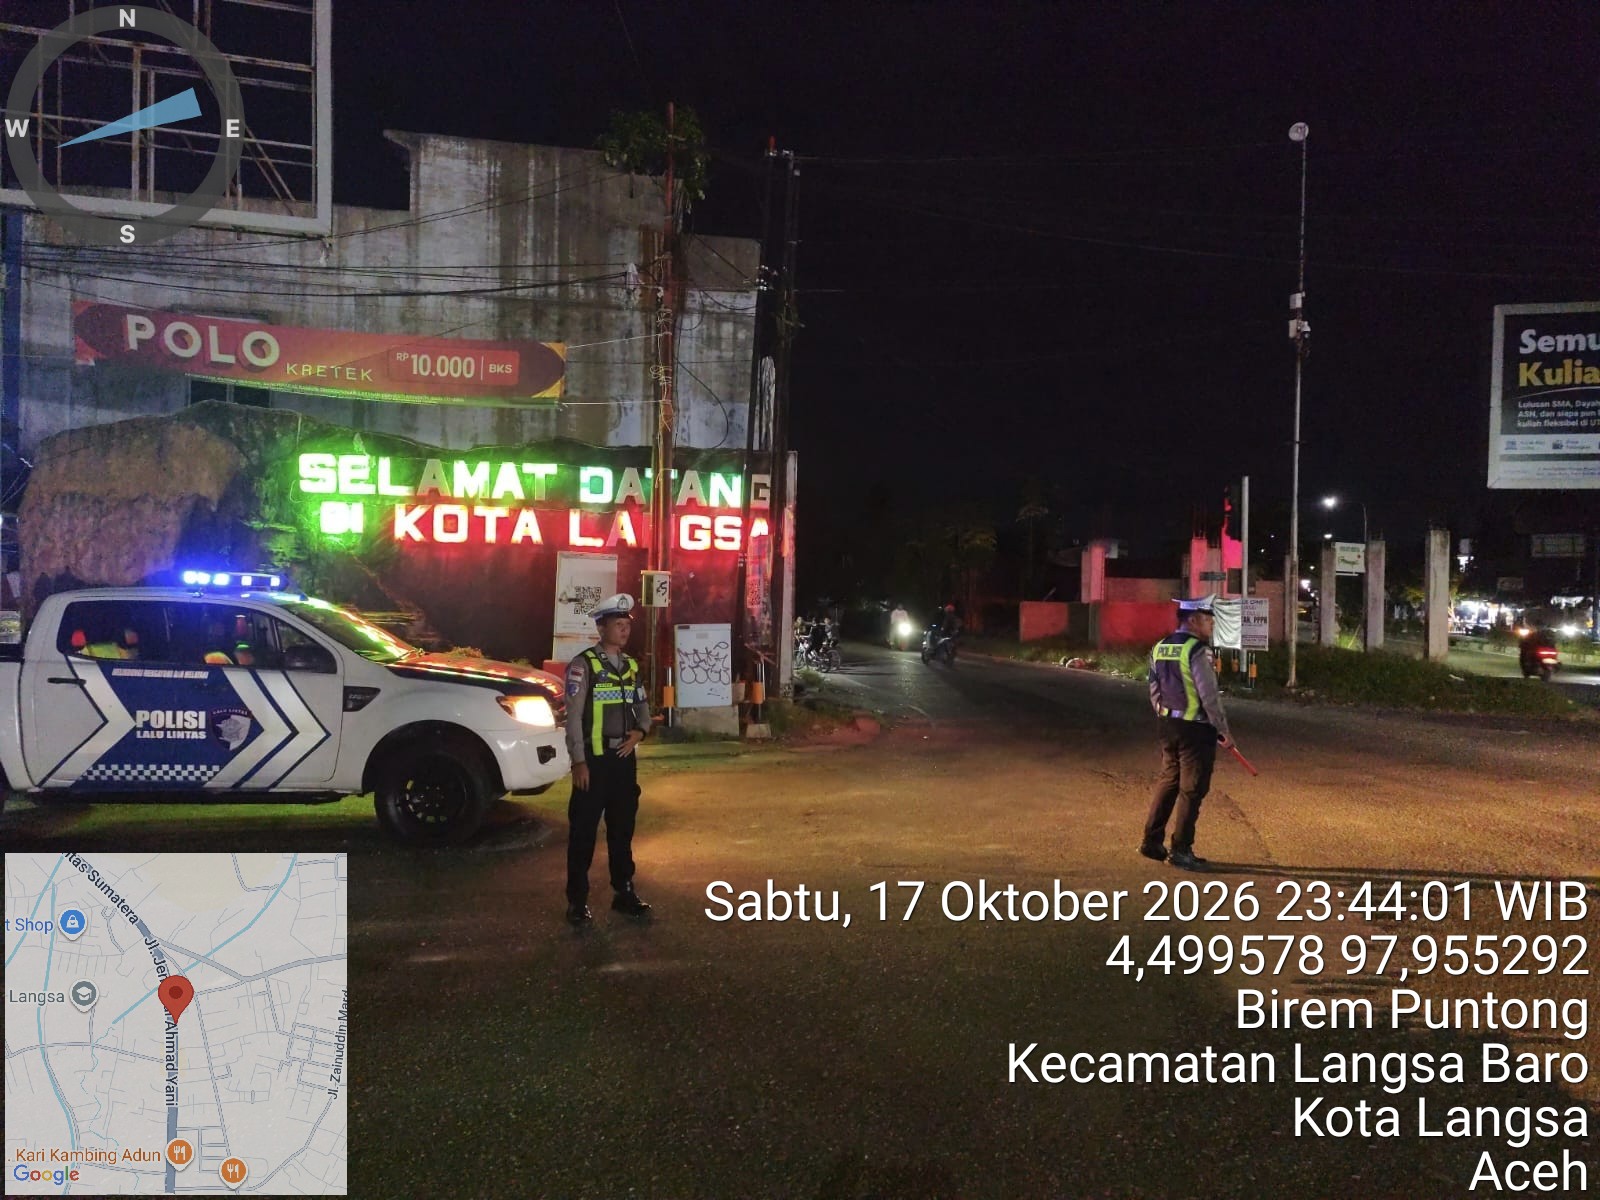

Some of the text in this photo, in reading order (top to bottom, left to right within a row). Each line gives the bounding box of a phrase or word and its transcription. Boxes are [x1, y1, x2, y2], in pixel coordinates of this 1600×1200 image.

[126, 314, 280, 367] POLO
[1519, 328, 1600, 355] Semu
[286, 363, 373, 382] KRETEK
[411, 354, 475, 378] 10.000
[489, 363, 513, 374] BKS
[1519, 358, 1600, 387] Kulia
[298, 453, 771, 510] SELAMAT DAANG
[394, 503, 543, 545] KOTA
[568, 508, 770, 551] LAGSA
[135, 710, 206, 729] POLISI
[136, 730, 207, 740] LALU LINTAS
